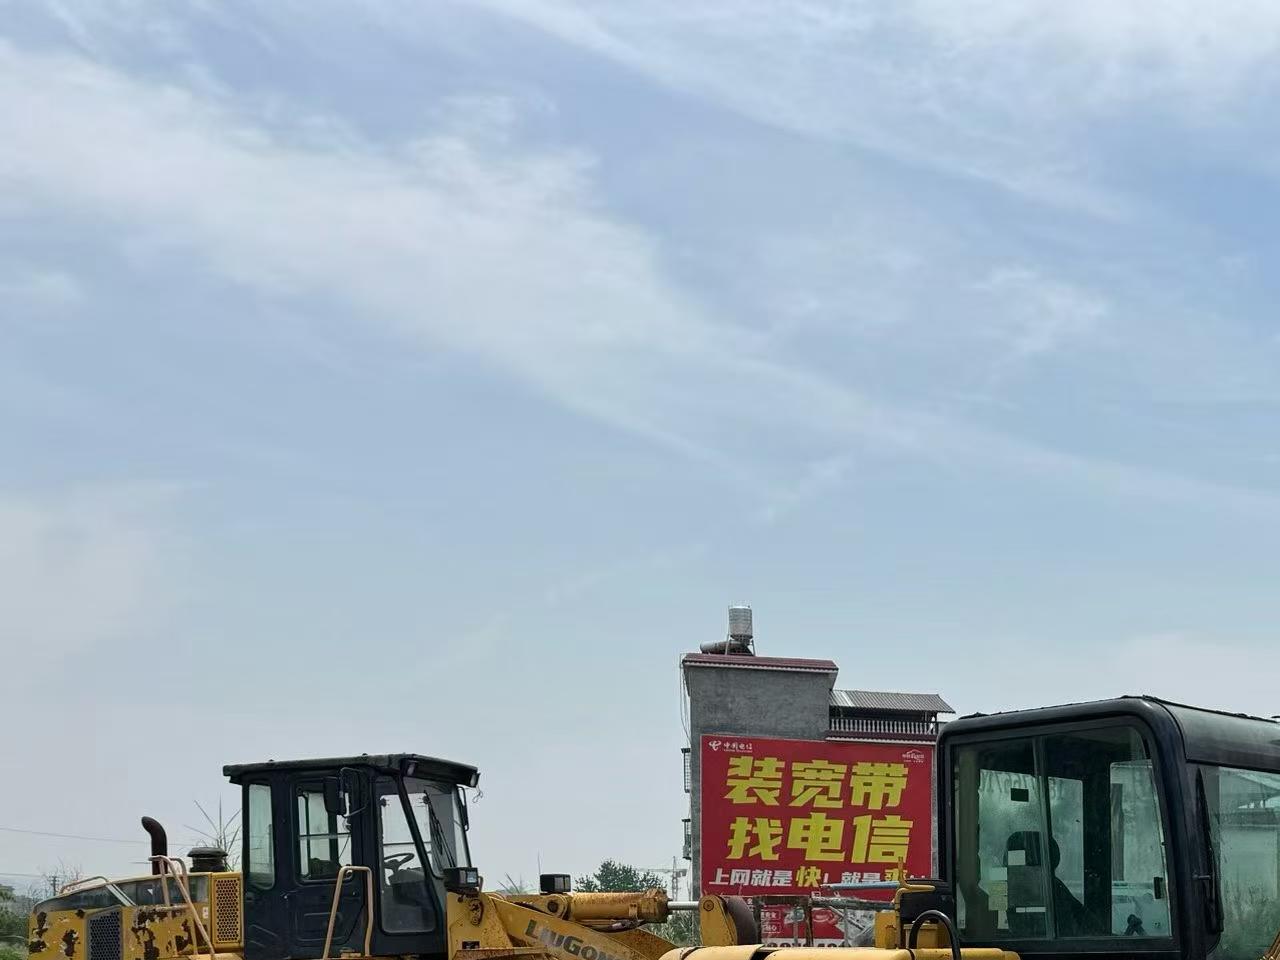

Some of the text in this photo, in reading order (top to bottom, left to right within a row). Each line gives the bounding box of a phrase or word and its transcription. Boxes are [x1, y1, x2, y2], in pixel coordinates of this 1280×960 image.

[724, 755, 909, 810] 装宽带
[726, 812, 914, 864] 找电信
